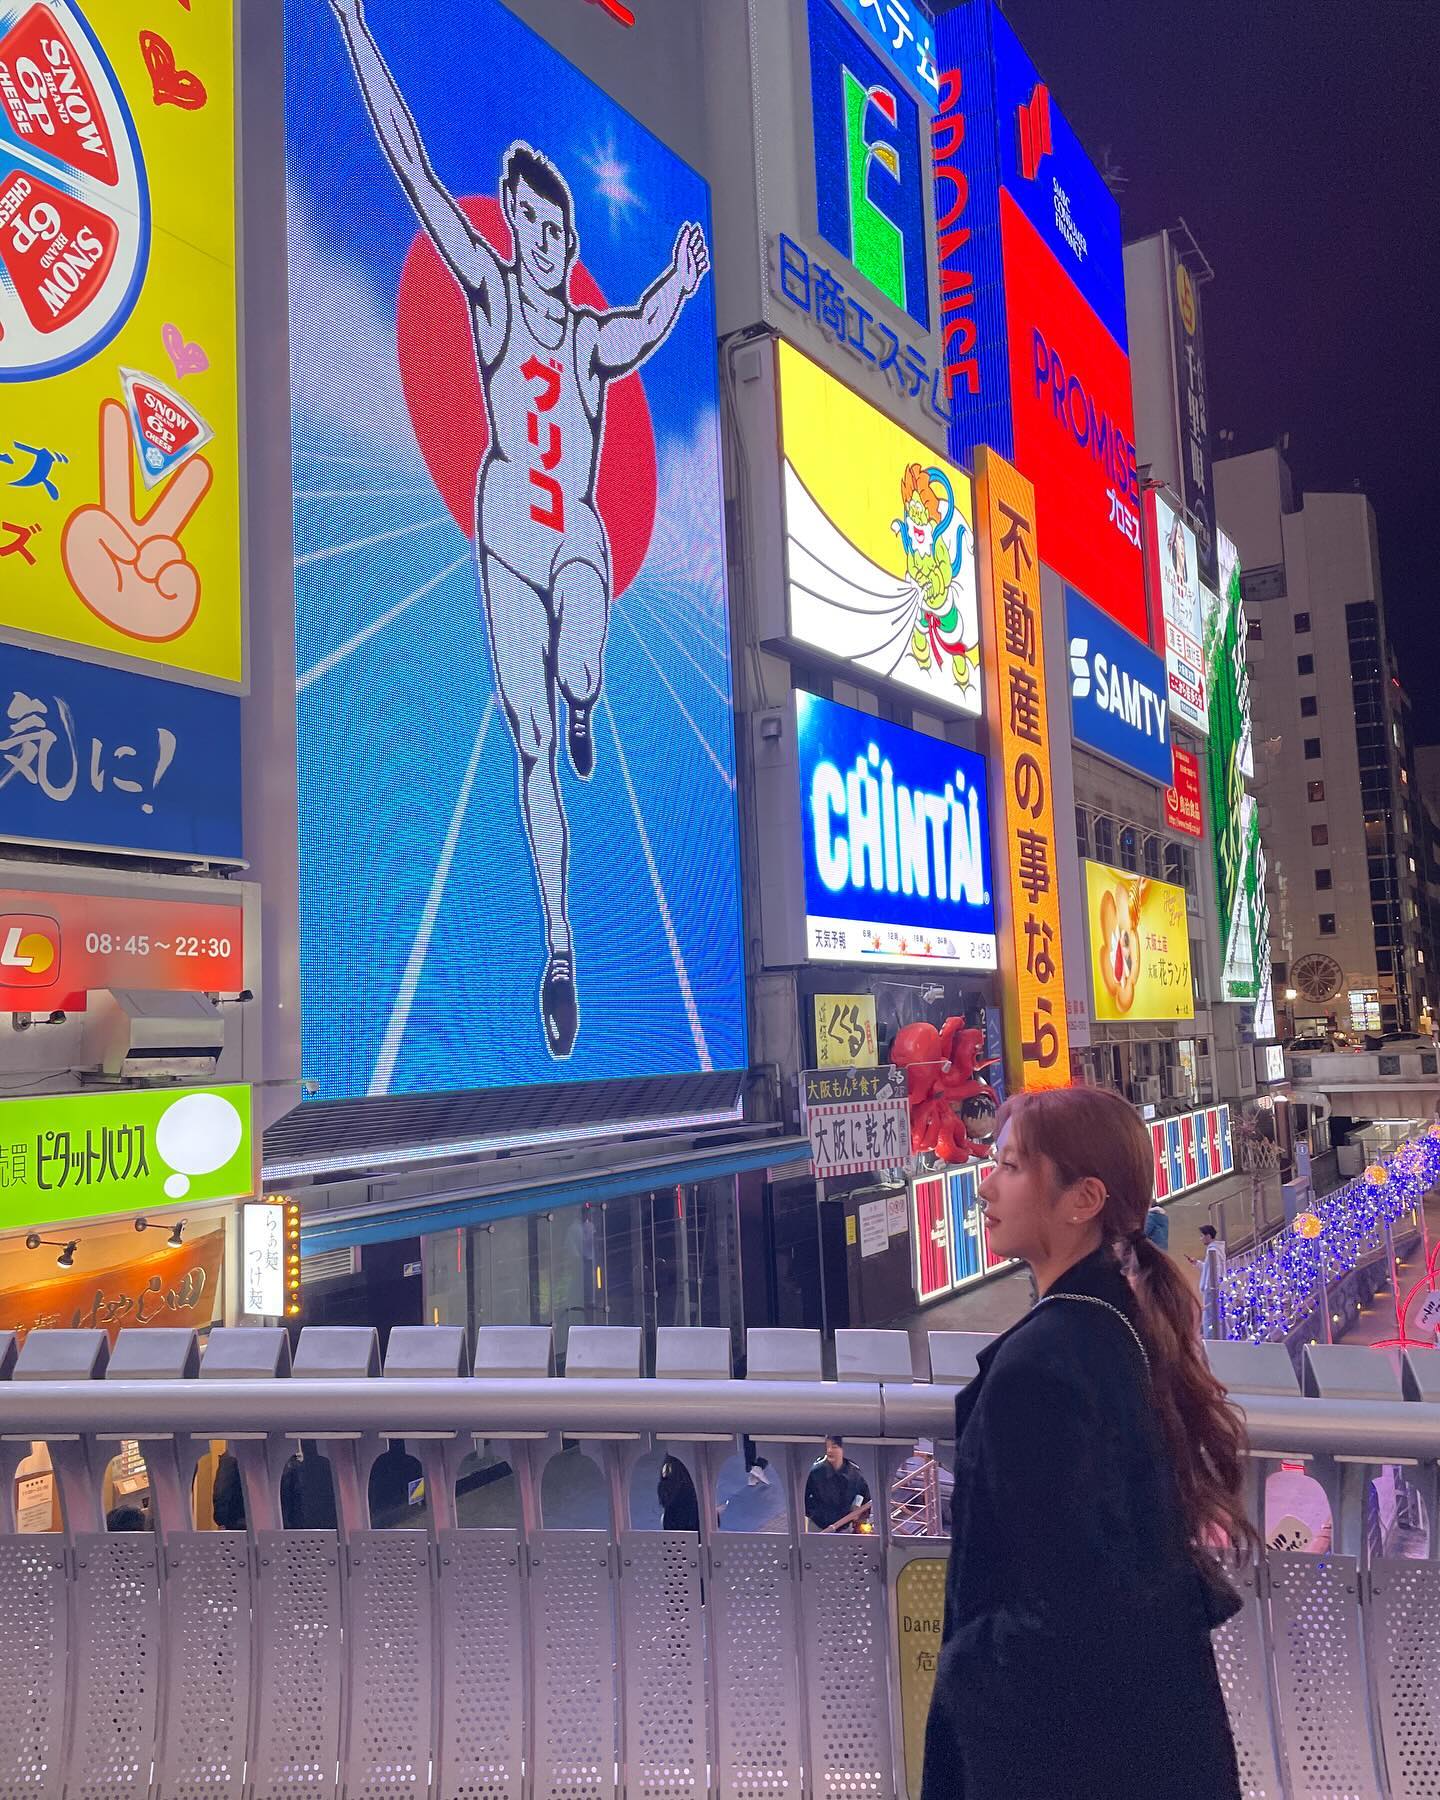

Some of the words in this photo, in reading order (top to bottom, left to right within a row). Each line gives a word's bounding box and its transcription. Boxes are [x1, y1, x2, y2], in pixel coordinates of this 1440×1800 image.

[16, 57, 55, 136] 6P
[40, 38, 107, 158] SNOW
[43, 71, 70, 124] BRAND
[12, 202, 61, 253] 6P
[40, 232, 69, 269] BRAND
[38, 226, 103, 317] SNOW
[144, 392, 190, 430] SNOW
[147, 415, 176, 442] 6P
[1033, 326, 1140, 506] PROMISE
[145, 430, 173, 453] CHEESE
[520, 353, 564, 534] グリコ
[1106, 488, 1143, 551] プロミス
[1094, 653, 1166, 744] SAMTY
[998, 498, 1060, 1070] 不動産の事なら
[808, 1076, 880, 1100] 大阪もんを食す
[37, 1123, 150, 1190] ピタットハウス
[815, 1112, 897, 1165] 大阪に乾杯
[903, 1615, 943, 1633] Dang
